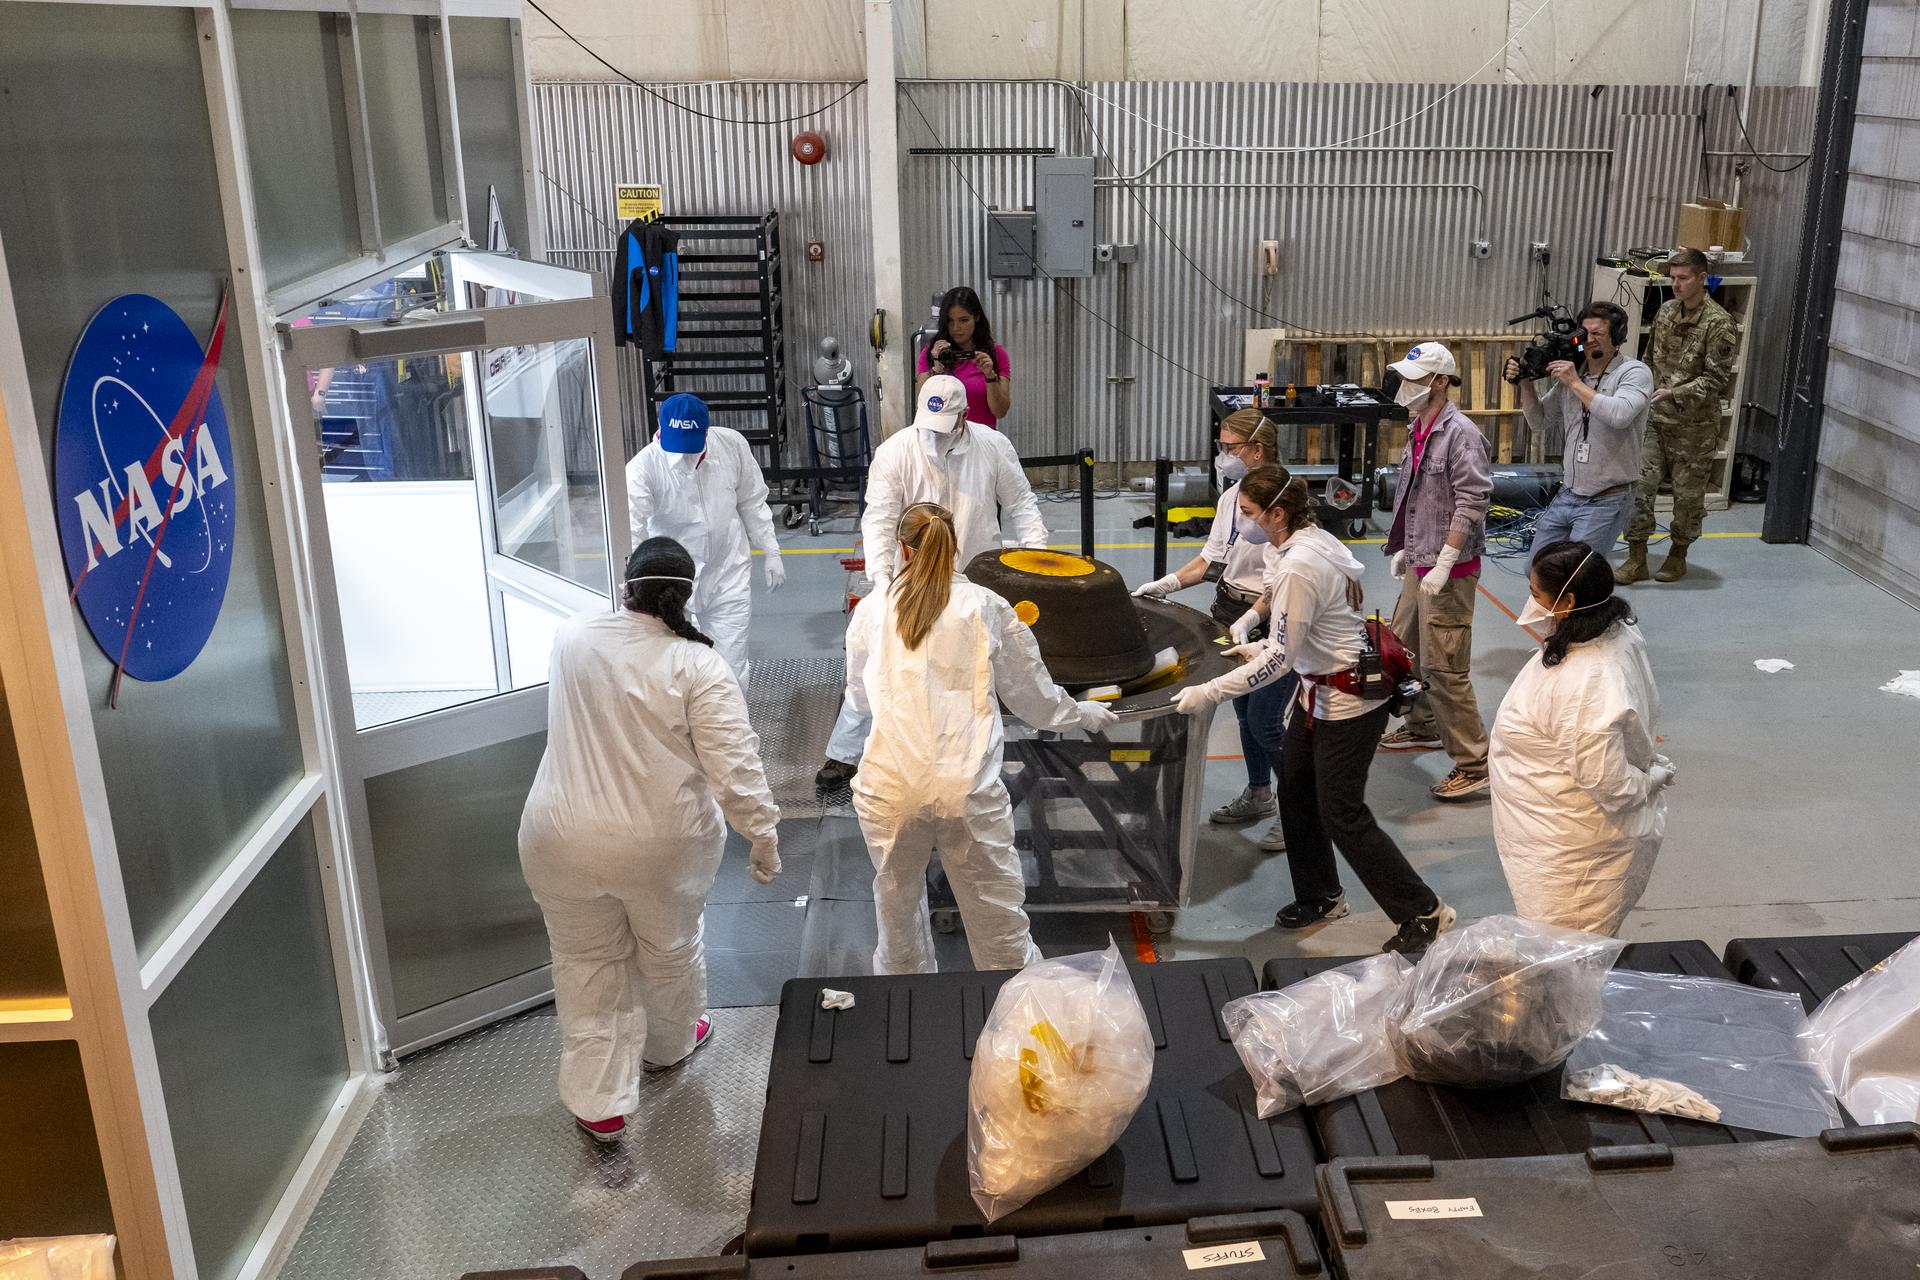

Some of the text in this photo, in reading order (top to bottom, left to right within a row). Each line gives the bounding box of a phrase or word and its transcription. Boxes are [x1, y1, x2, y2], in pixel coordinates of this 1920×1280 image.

[619, 189, 659, 198] CAUTION
[668, 418, 699, 429] NASA
[73, 422, 228, 573] NASA
[1277, 610, 1288, 646] REX
[1202, 1247, 1255, 1263] STUFFS
